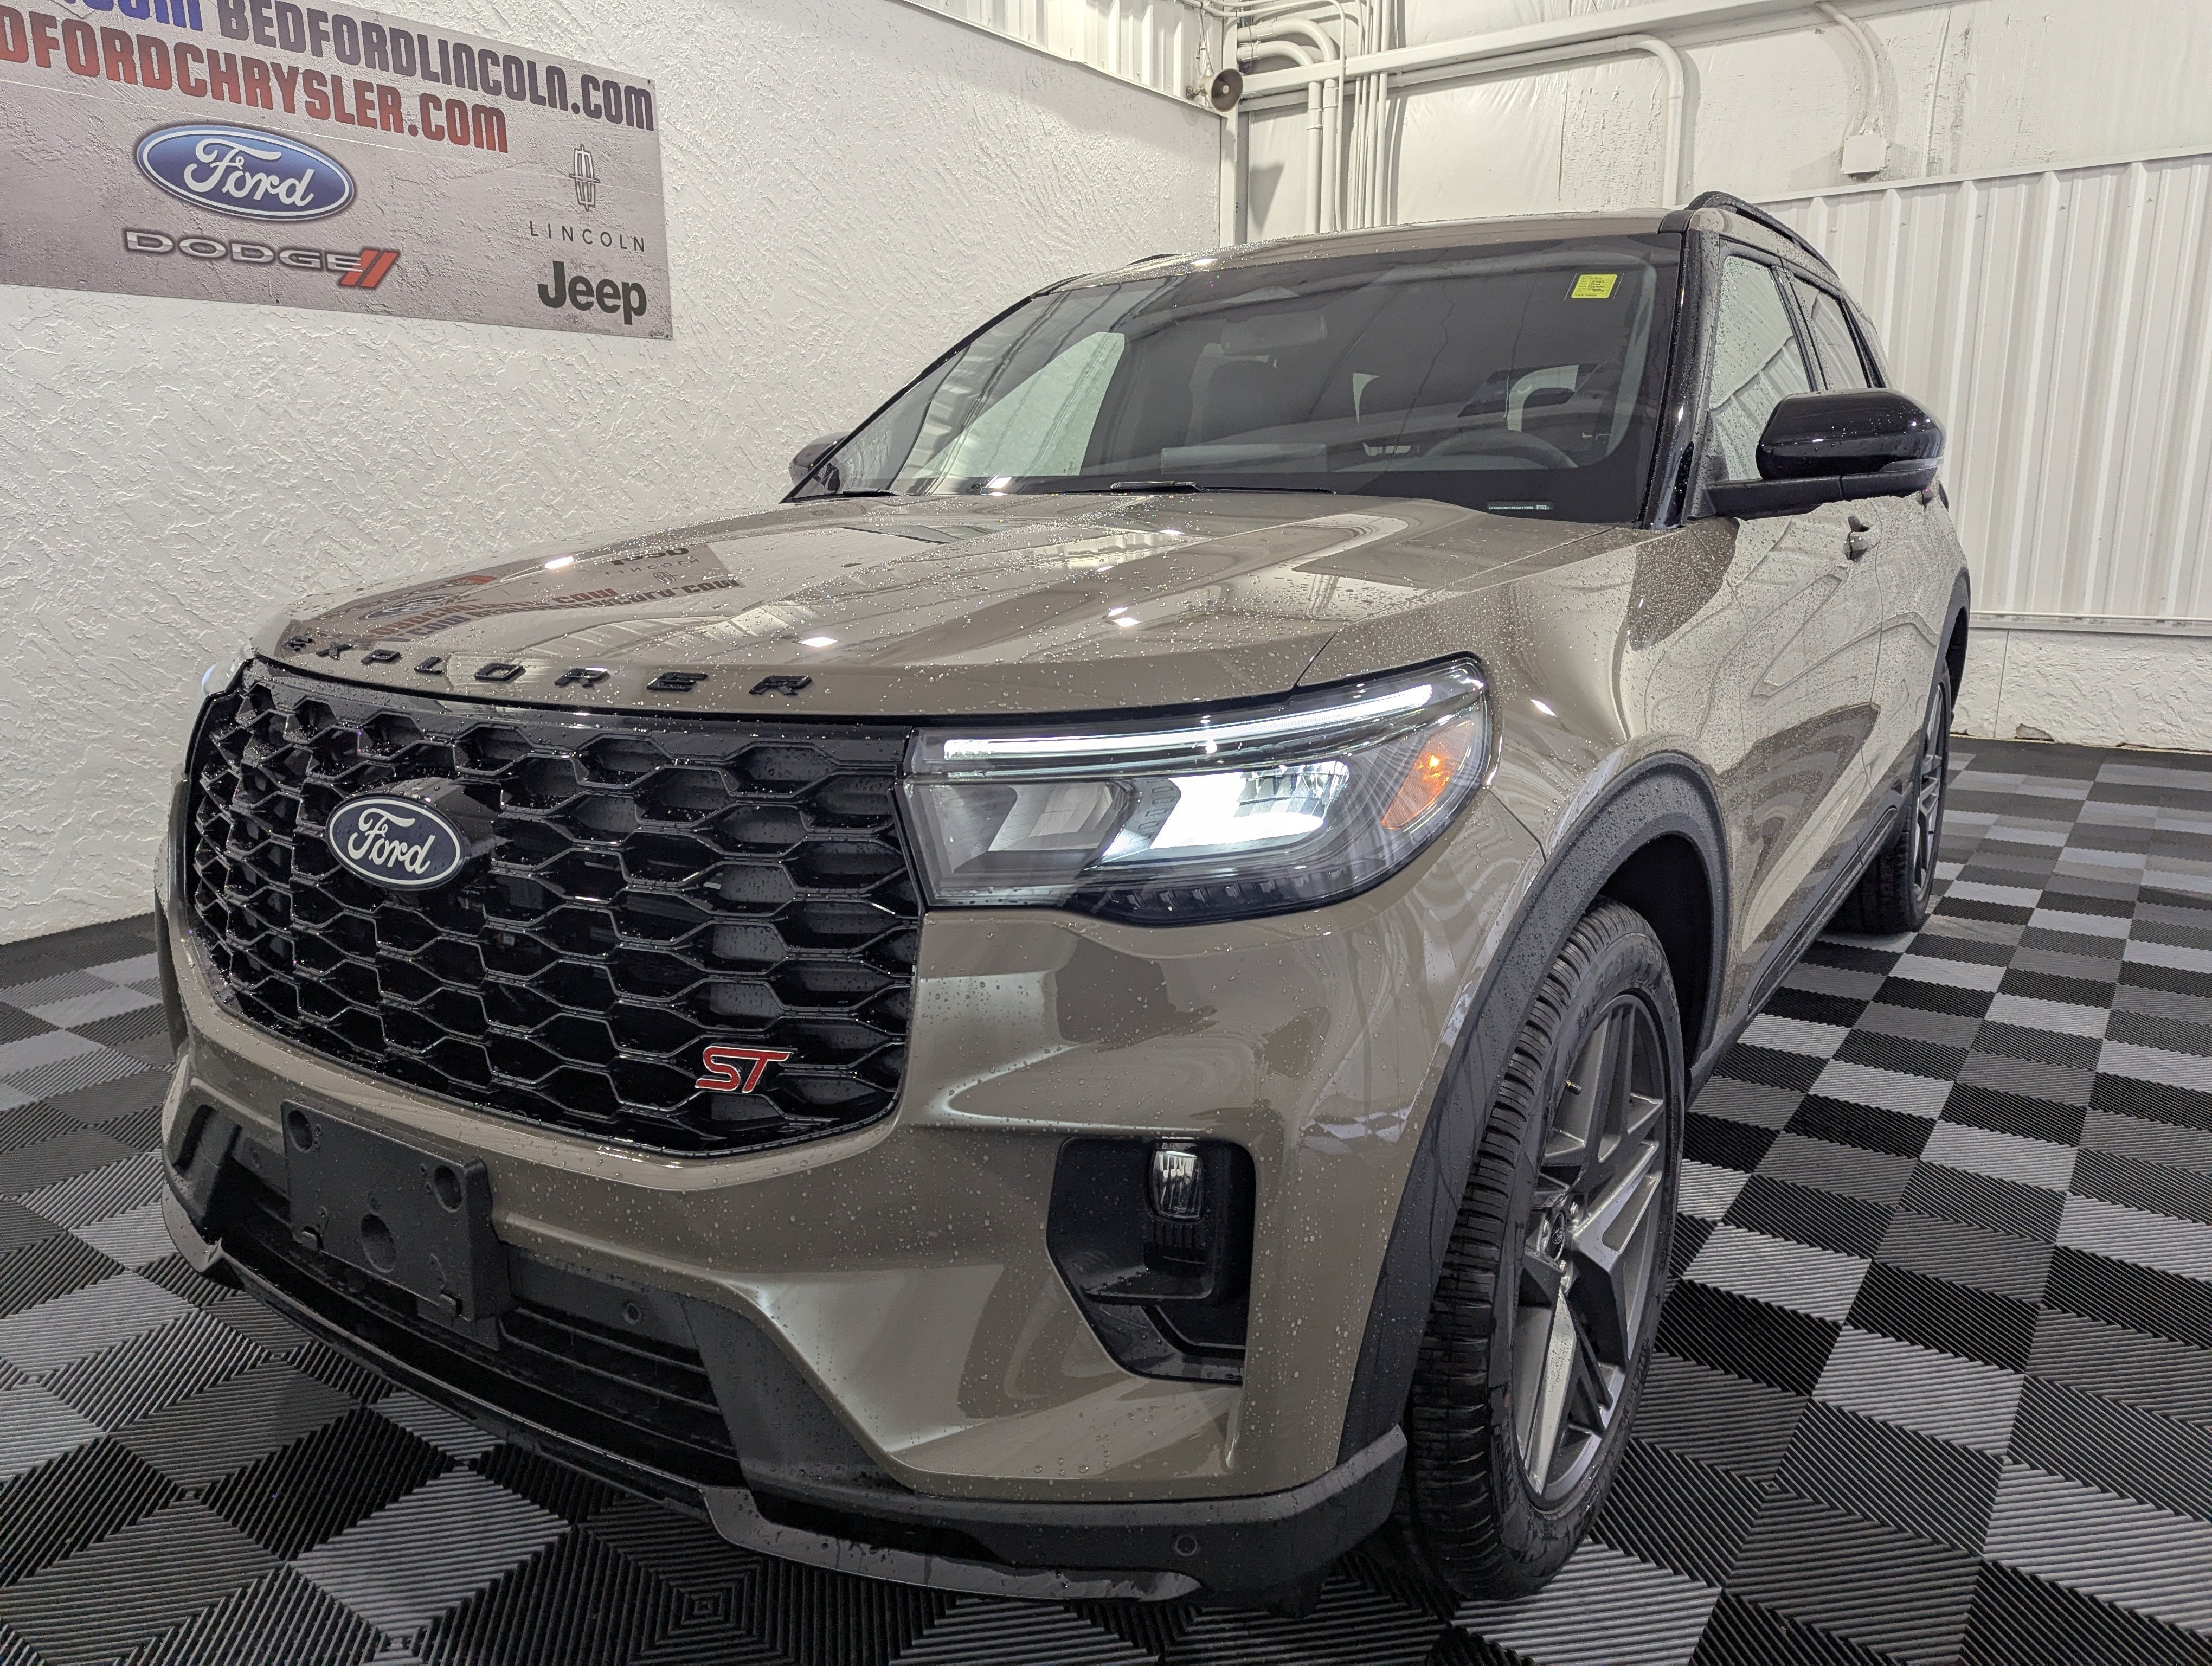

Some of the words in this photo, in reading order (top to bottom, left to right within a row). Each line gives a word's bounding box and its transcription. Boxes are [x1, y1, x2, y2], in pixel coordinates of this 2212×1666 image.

[184, 138, 314, 207] Ford
[126, 231, 363, 272] DODGE
[530, 220, 645, 252] LINCOLN
[537, 260, 647, 325] Jeep
[282, 635, 814, 697] EXPLORER
[348, 808, 436, 874] Ford
[695, 1045, 794, 1093] ST
